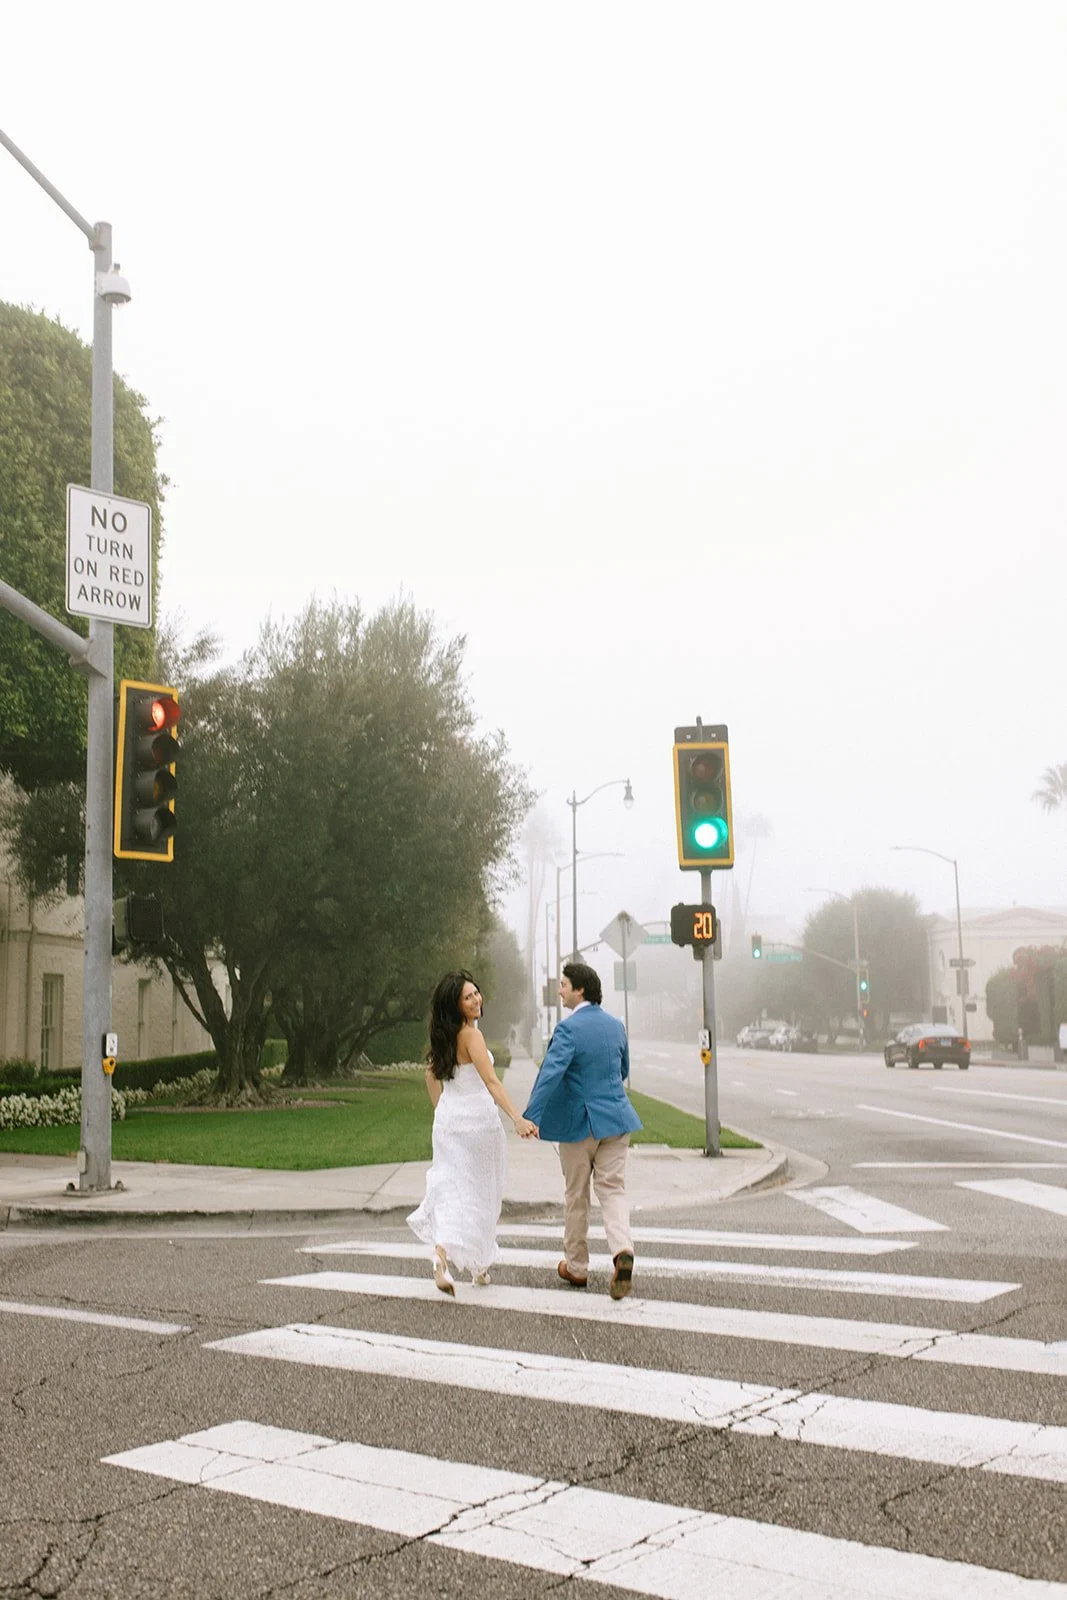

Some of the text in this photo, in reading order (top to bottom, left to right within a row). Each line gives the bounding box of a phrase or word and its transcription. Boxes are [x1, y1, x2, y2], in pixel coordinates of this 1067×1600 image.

[91, 505, 127, 533] NO
[86, 533, 133, 561] TURN
[73, 557, 144, 587] ON RED
[77, 584, 141, 611] ARROW
[693, 912, 713, 939] 20
